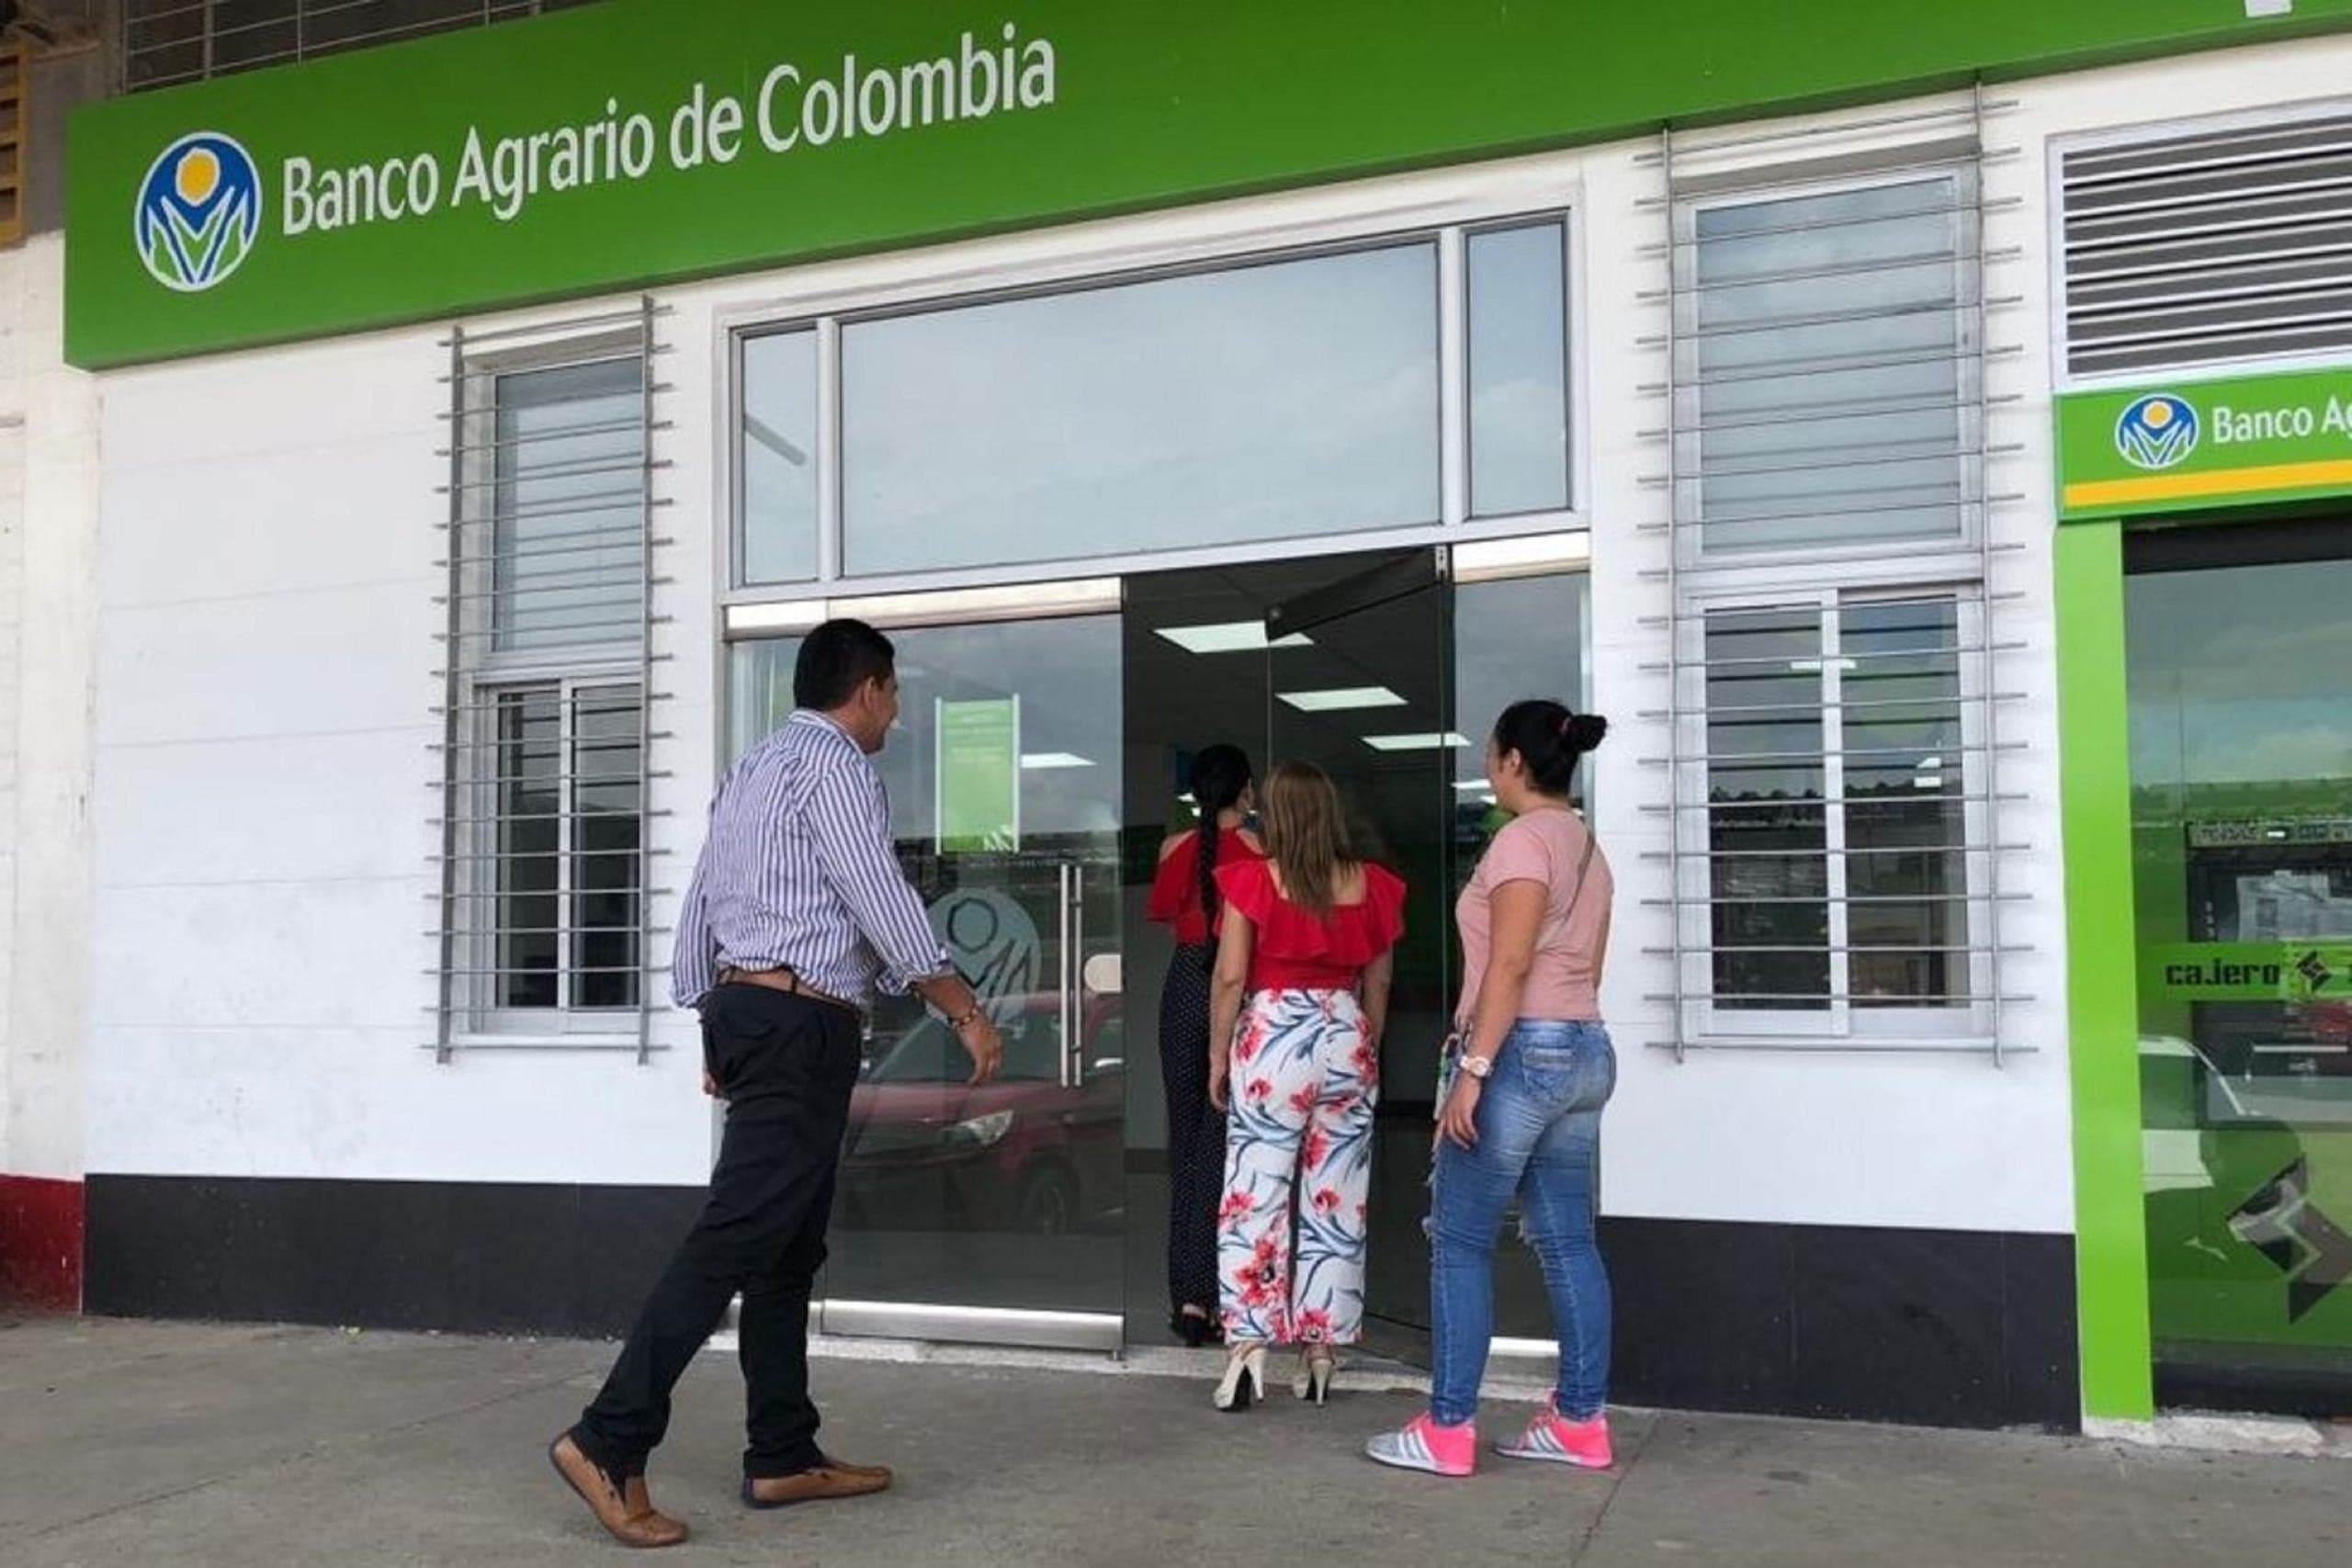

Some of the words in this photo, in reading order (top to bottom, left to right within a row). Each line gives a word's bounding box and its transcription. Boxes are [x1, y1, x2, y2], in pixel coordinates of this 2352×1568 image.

[283, 152, 439, 235] Banco
[450, 97, 655, 220] Agrario
[670, 83, 744, 170] de
[757, 21, 1056, 153] Colombia
[2212, 406, 2313, 443] Banco
[2165, 958, 2281, 987] cajero
